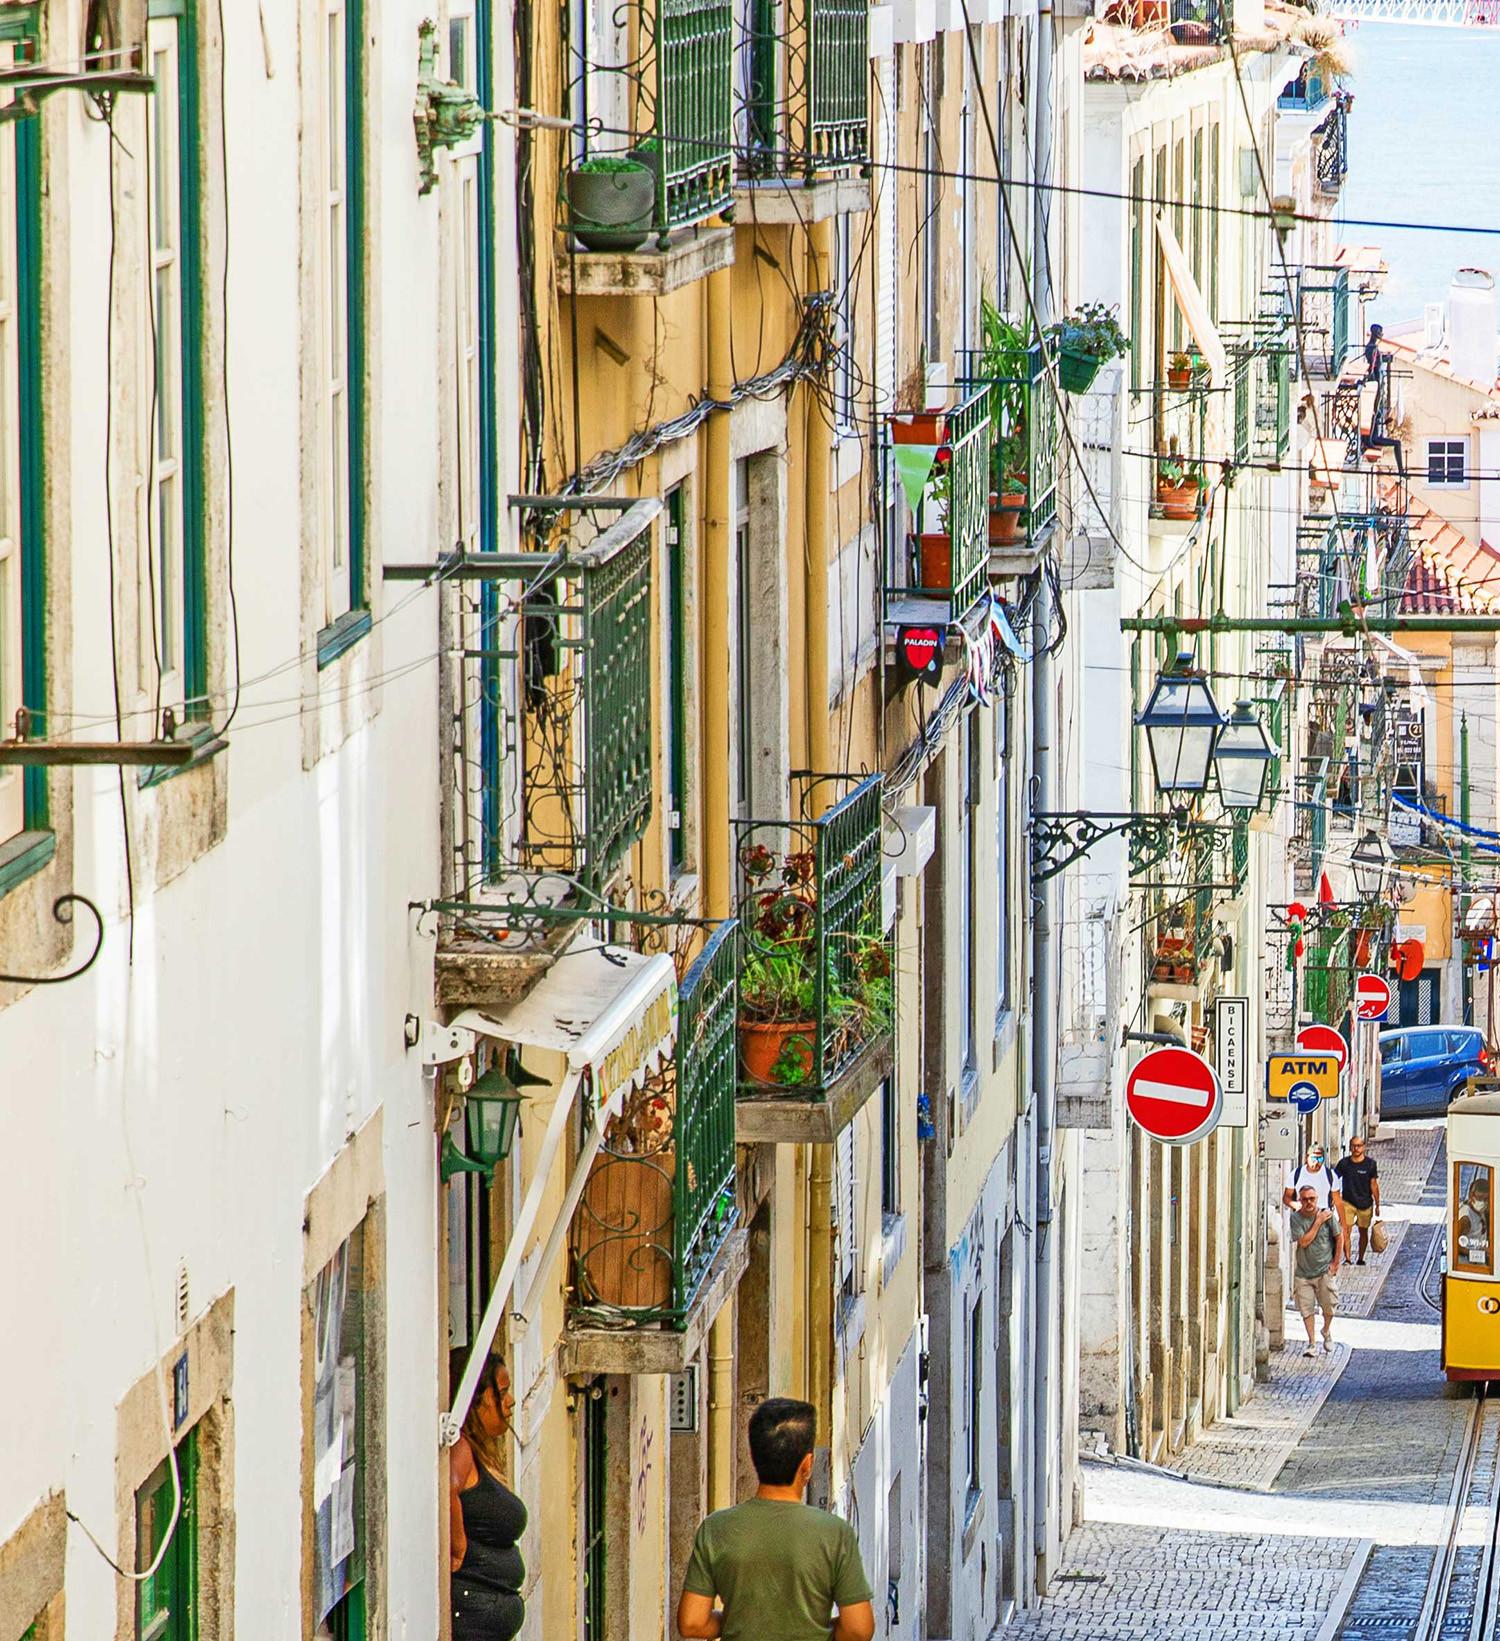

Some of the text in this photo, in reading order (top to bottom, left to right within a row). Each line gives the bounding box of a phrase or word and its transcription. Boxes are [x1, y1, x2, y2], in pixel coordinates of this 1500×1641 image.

[904, 638, 938, 647] PALADIN
[1227, 1005, 1236, 1089] BICAENSE
[1281, 1062, 1327, 1075] ATM
